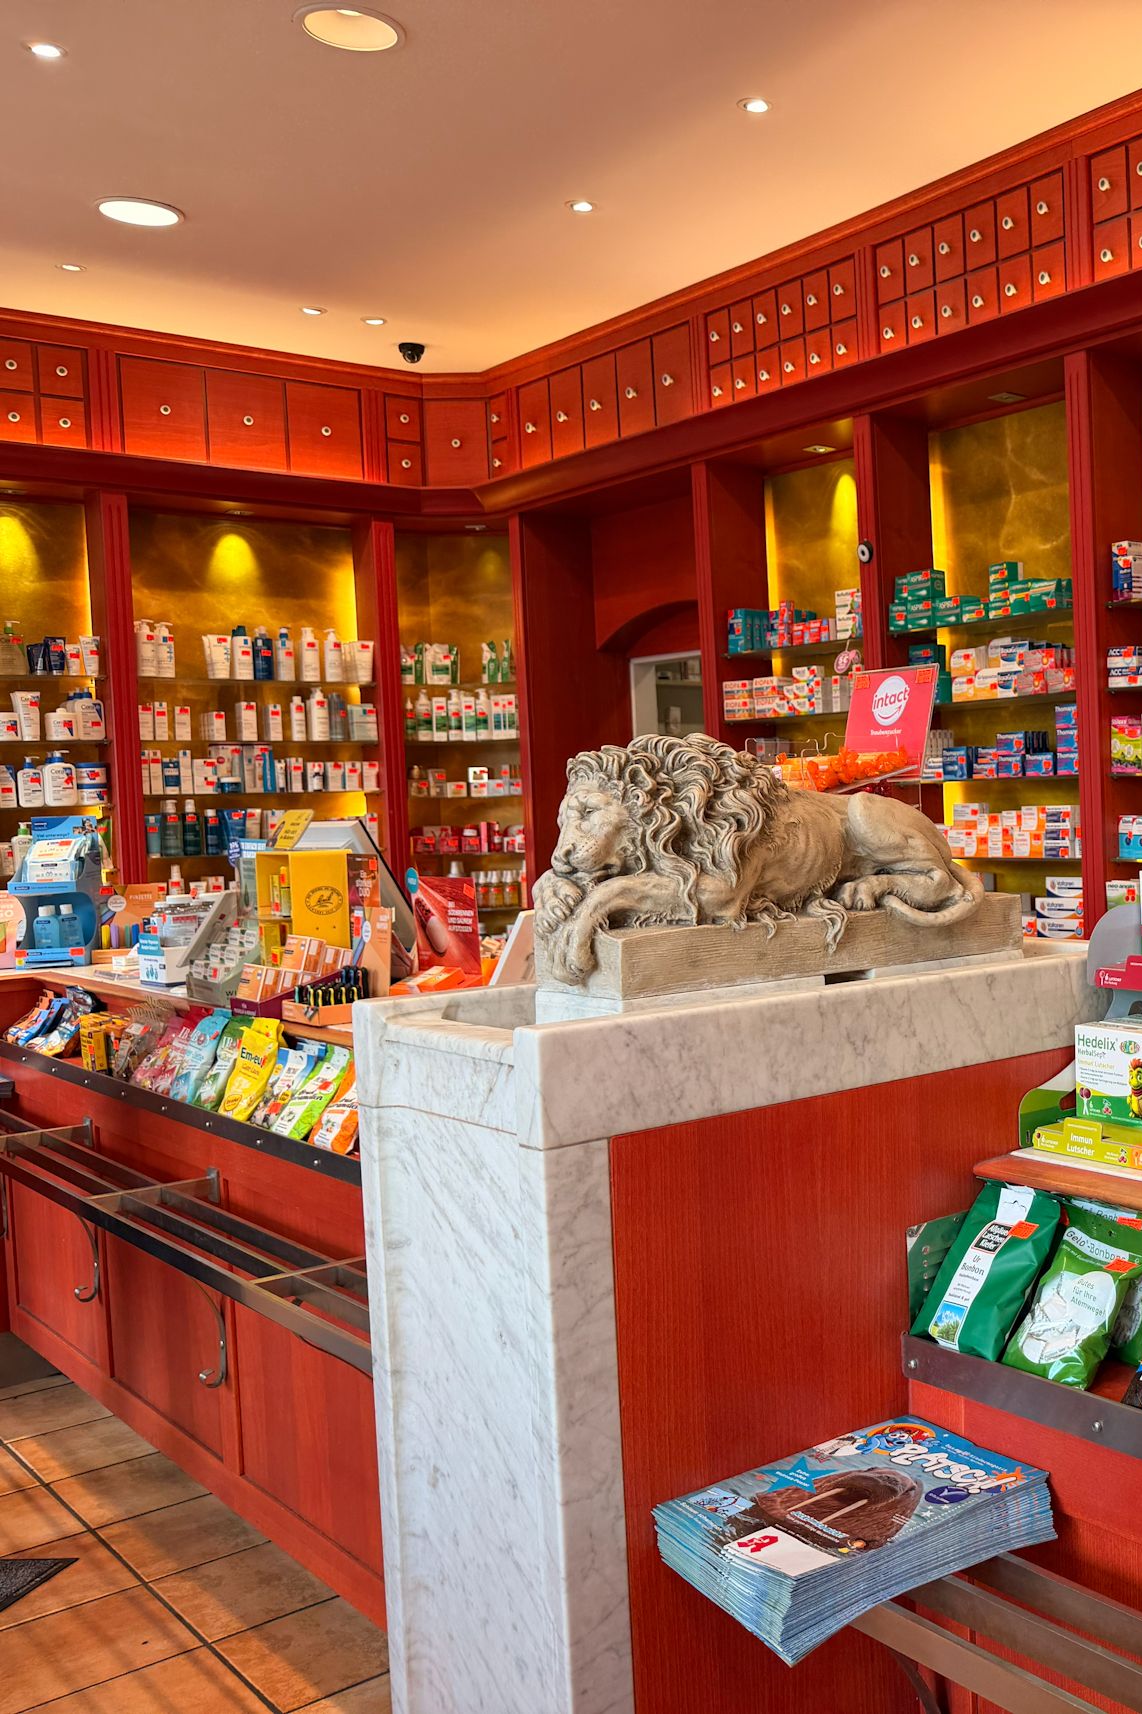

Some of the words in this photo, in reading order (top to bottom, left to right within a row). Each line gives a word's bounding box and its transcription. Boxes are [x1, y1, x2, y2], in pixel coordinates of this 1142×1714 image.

[874, 687, 909, 710] intact
[1077, 1034, 1115, 1051] Hedelix
[241, 1048, 263, 1065] Em-eu
[1070, 1133, 1093, 1144] Immun
[1066, 1144, 1095, 1156] Lutscher
[973, 1255, 981, 1263] Ur
[961, 1263, 984, 1275] Bonbon
[1078, 1278, 1095, 1290] Gutes
[1084, 1289, 1097, 1302] Ihre
[890, 1443, 1016, 1493] PLATSCH!
